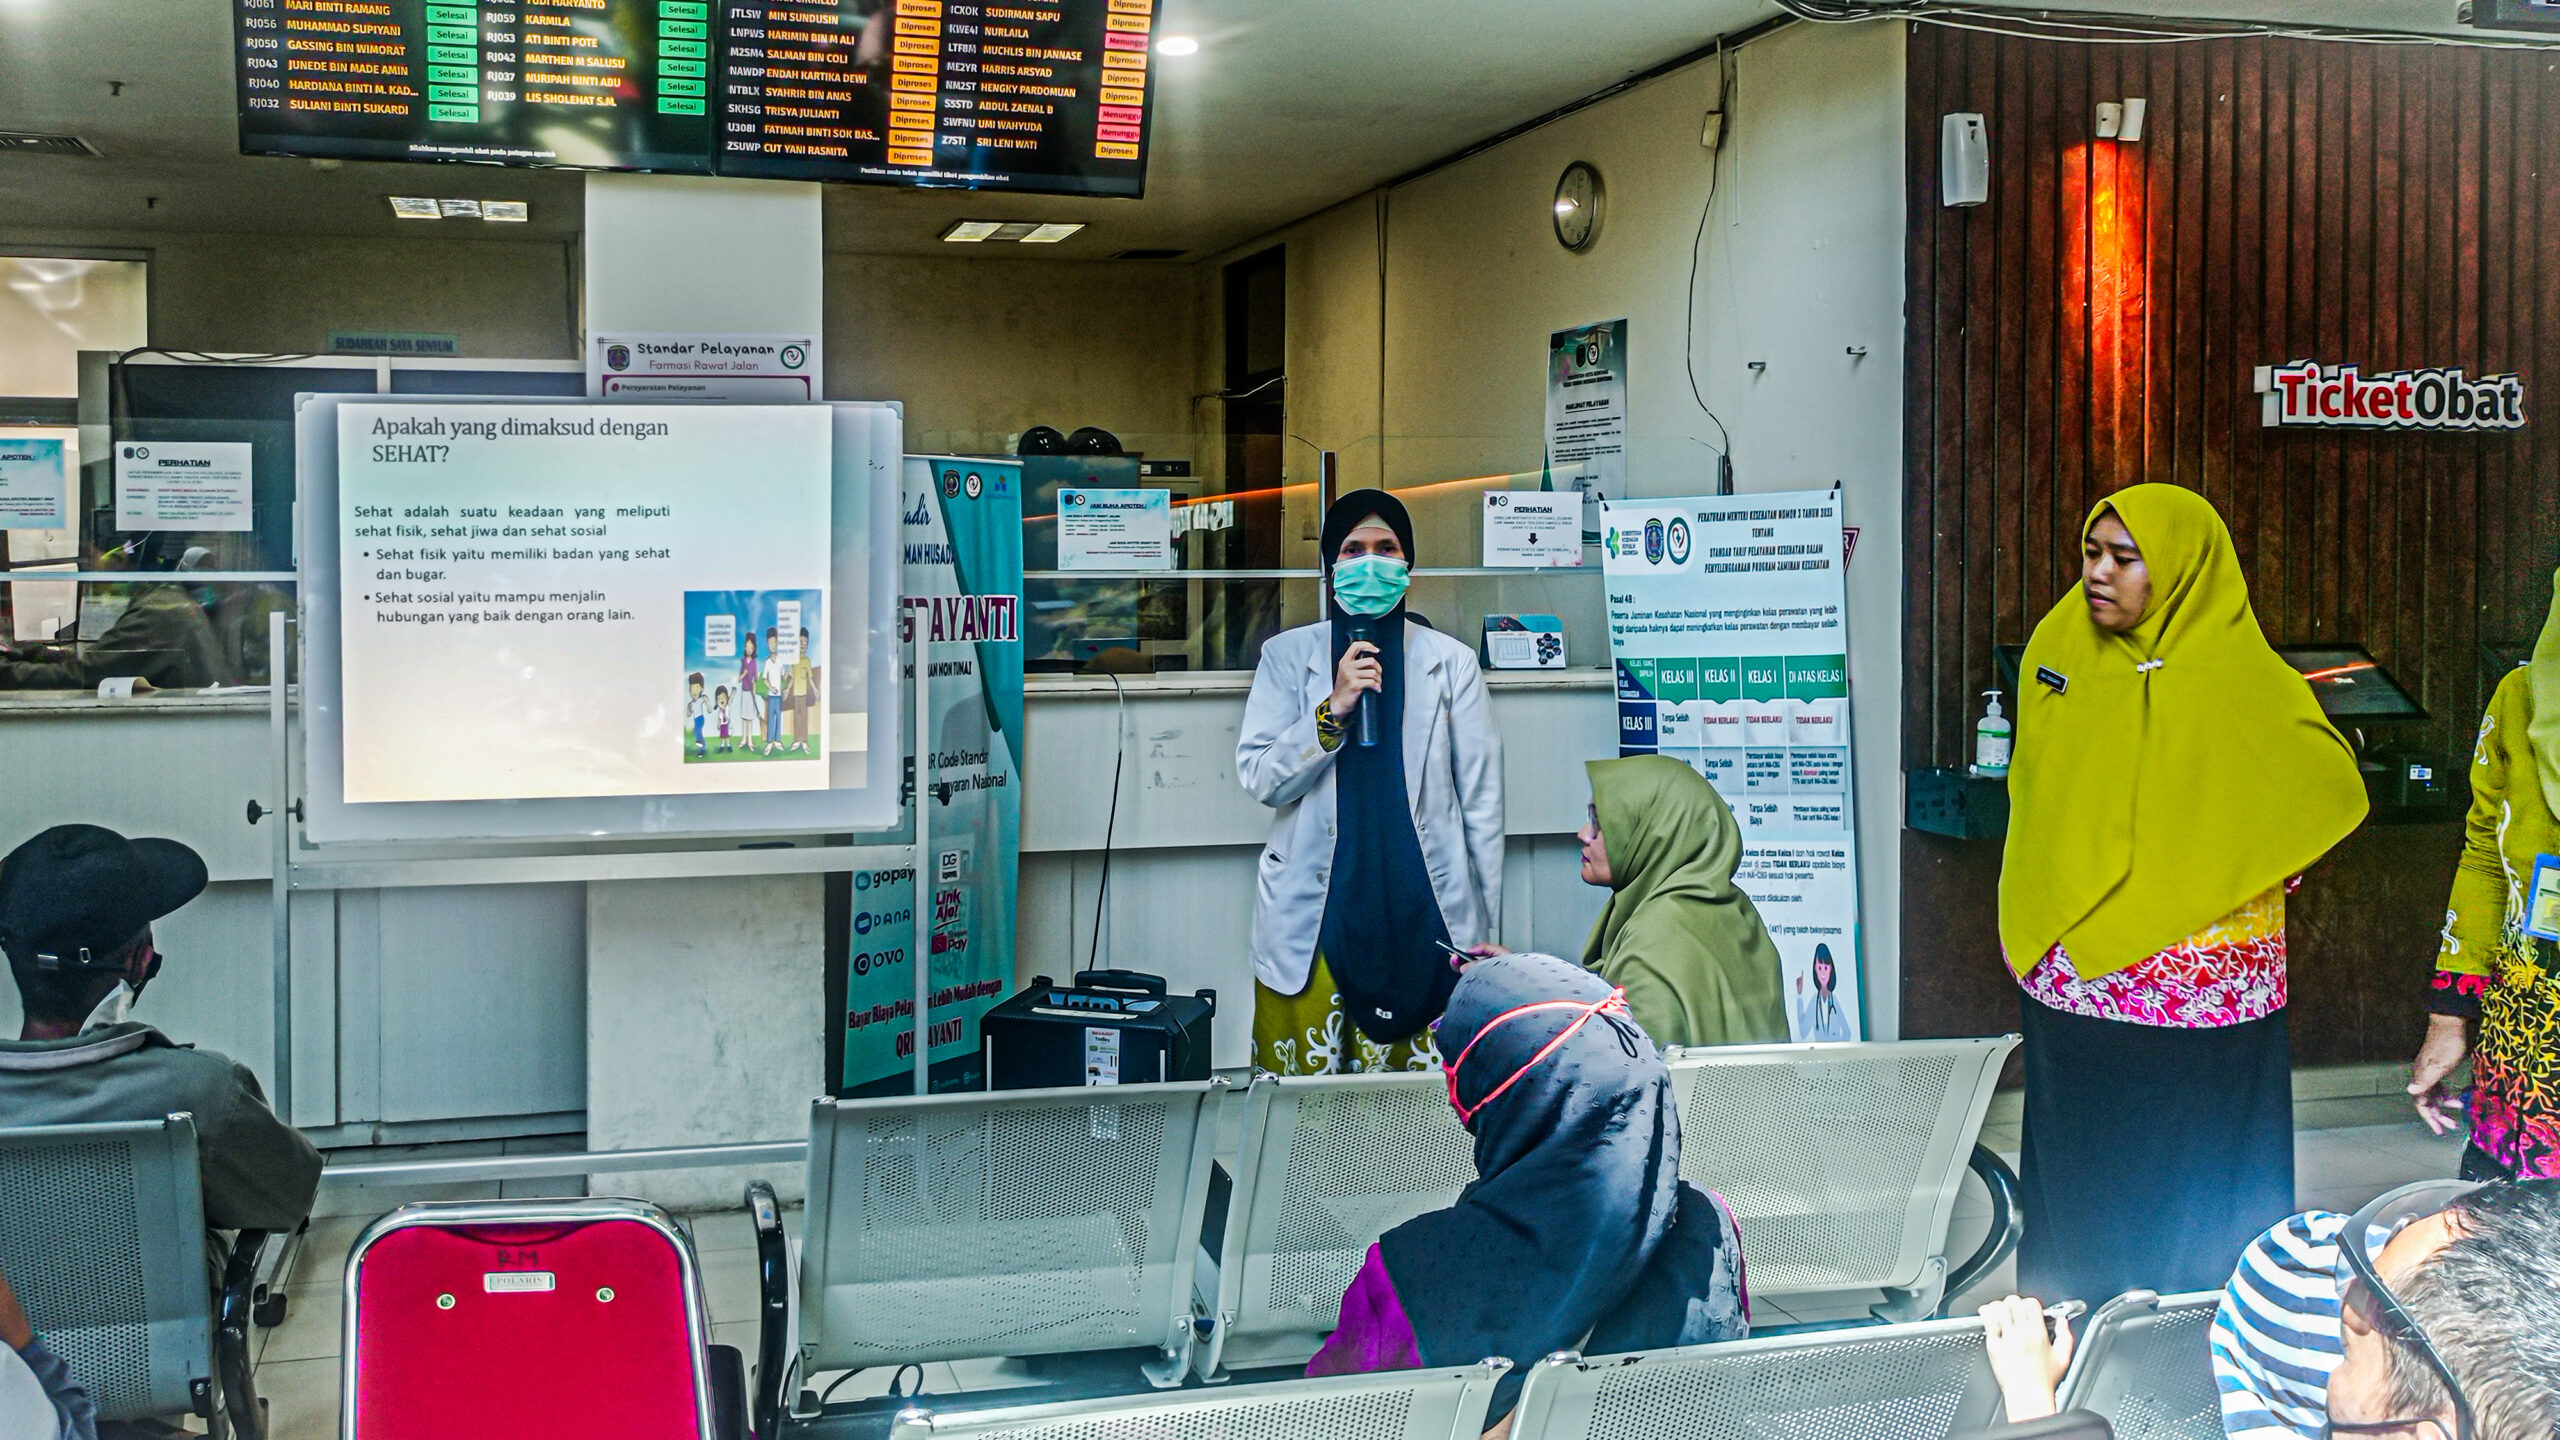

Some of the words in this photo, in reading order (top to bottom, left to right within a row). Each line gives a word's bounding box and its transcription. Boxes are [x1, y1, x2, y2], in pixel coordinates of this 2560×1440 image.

[286, 0, 313, 11] MARI
[315, 2, 343, 13] BINTI
[346, 4, 390, 16] RAMANG
[902, 3, 936, 13] Diproses
[986, 8, 1034, 19] SUDIRMAN
[1036, 10, 1060, 22] SAPU
[487, 13, 515, 23] RJ059
[525, 15, 570, 27] KARMILA
[769, 11, 787, 22] MIN
[789, 12, 839, 25] SUNDUSIN
[246, 18, 276, 29] RJ056
[287, 20, 350, 33] MUHAMMAD
[353, 23, 401, 36] SUPIYANI
[984, 27, 1029, 39] NURLAILA
[487, 33, 515, 43] RJ053
[525, 35, 541, 45] ATI
[543, 36, 570, 46] BINTI
[572, 37, 598, 48] POTE
[768, 30, 808, 42] HARIMIN
[811, 33, 827, 43] BIN
[829, 34, 838, 44] M
[840, 35, 855, 45] ALI
[247, 38, 278, 49] RJ050
[288, 40, 333, 52] GASSING
[336, 42, 354, 53] BIN
[356, 43, 406, 56] WIMORAT
[248, 58, 278, 69] RJ043
[289, 60, 327, 72] JUNEDE
[330, 62, 348, 72] BIN
[350, 63, 379, 74] MADE
[381, 64, 408, 76] AMIN
[487, 52, 515, 62] RJ042
[525, 54, 573, 66] MARTHEN
[576, 56, 584, 66] M
[587, 57, 625, 68] SALUSU
[982, 64, 1015, 75] HARRIS
[1017, 66, 1052, 77] ARSYAD
[250, 78, 280, 89] RJ040
[289, 80, 343, 92] HARDIANA
[346, 82, 372, 93] BINTI
[487, 72, 515, 82] RJ037
[525, 73, 569, 85] NURIPAH
[572, 75, 598, 86] BINTI
[600, 77, 621, 87] ABU
[488, 91, 516, 101] RJ039
[525, 93, 542, 103] LIS
[544, 94, 594, 105] SHOLEHAT
[765, 87, 806, 98] SYAHRIR
[808, 89, 824, 99] BIN
[826, 90, 851, 101] ANAS
[981, 84, 1018, 95] HENGKY
[1019, 85, 1076, 98] PARDOMUAN
[250, 98, 279, 109] RJ032
[290, 100, 331, 111] SULIANI
[334, 102, 361, 112] BINTI
[364, 103, 408, 115] SUKARDI
[765, 106, 797, 116] TRISYA
[799, 107, 839, 119] JULIANTI
[978, 119, 996, 129] UMI
[998, 120, 1042, 132] WAHYUDA
[638, 342, 694, 354] Standar
[701, 342, 774, 357] Pelayanan
[650, 360, 691, 370] Farmasi
[694, 360, 727, 369] Rawat
[731, 360, 758, 370] Jalan
[2279, 368, 2518, 421] TicketObat
[372, 416, 446, 439] Apakah
[450, 420, 496, 440] yang
[501, 417, 595, 436] dimaksud
[599, 418, 668, 440] dengan
[373, 444, 449, 462] SEHAT?
[355, 505, 393, 518] Sehat
[404, 505, 449, 518] adalah
[460, 507, 496, 518] suatu
[509, 505, 563, 517] keadaan
[575, 508, 605, 519] yang
[617, 505, 670, 519] meliputi
[355, 526, 392, 537] sehat
[396, 525, 427, 538] fisik,
[431, 525, 467, 537] sehat
[471, 525, 498, 539] jiwa
[503, 525, 526, 536] dan
[531, 525, 566, 536] sehat
[571, 525, 607, 536] sosial
[377, 549, 414, 560] Sehat
[420, 548, 446, 560] fisik
[452, 549, 484, 562] yaitu
[491, 548, 547, 559] memiliki
[553, 548, 593, 559] badan
[599, 550, 629, 561] yang
[635, 547, 670, 559] sehat
[924, 543, 955, 565] HUSADA
[377, 568, 401, 580] dan
[406, 568, 446, 582] bugar.
[375, 591, 413, 603] Sehat
[417, 591, 454, 602] sosial
[458, 592, 490, 604] yaitu
[495, 593, 545, 604] mampu
[550, 591, 605, 603] menjalin
[377, 610, 444, 624] hubungan
[449, 612, 479, 624] yang
[484, 610, 510, 621] baik
[515, 610, 563, 622] dengan
[567, 611, 604, 622] orang
[608, 610, 634, 620] lain.
[1661, 670, 1685, 683] KELAS
[1705, 669, 1729, 683] KELAS
[1730, 669, 1736, 682] II
[1748, 670, 1772, 683] KELAS
[1789, 671, 1794, 682] DI
[1797, 671, 1816, 682] ATAS
[1817, 670, 1840, 682] KELAS
[1623, 717, 1644, 730] KELAS
[873, 868, 915, 888] gopay
[936, 888, 960, 906] Link
[874, 949, 904, 968] OVO
[497, 1277, 542, 1285] POLARIS
